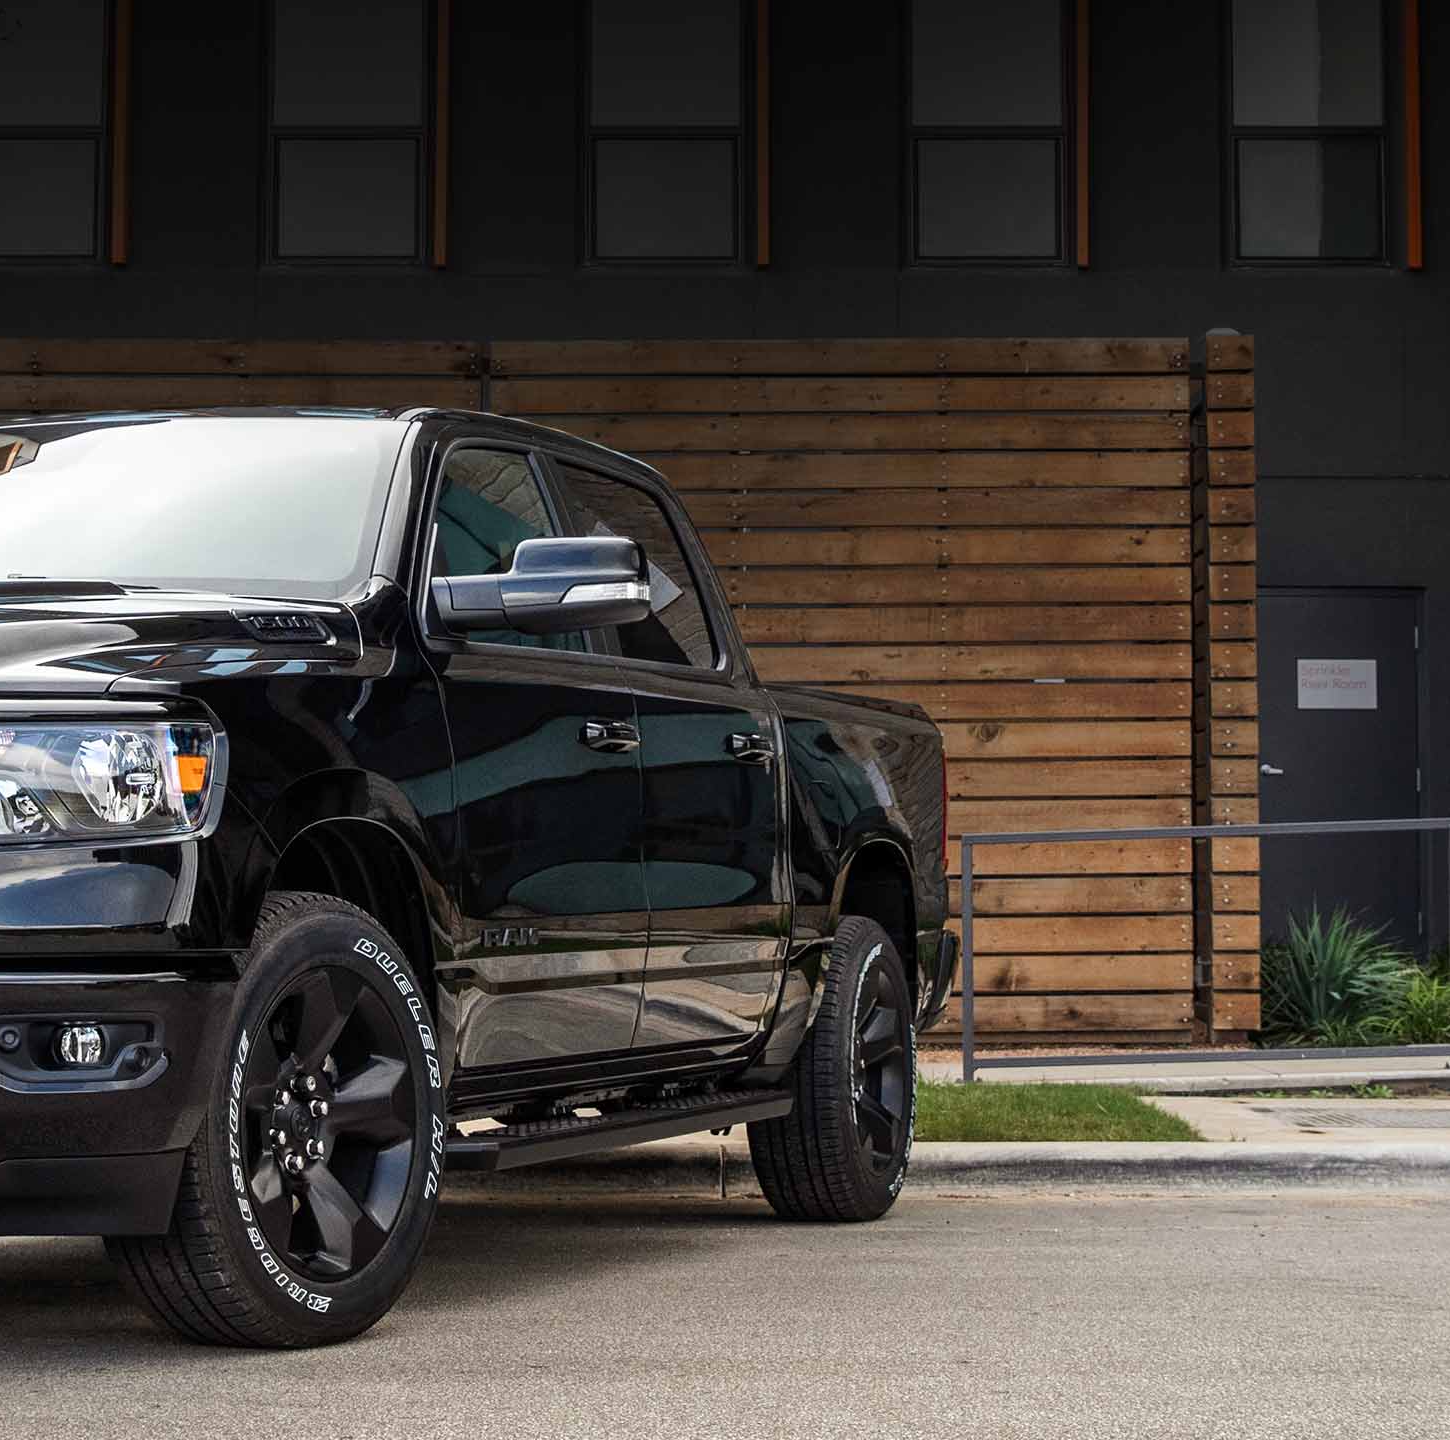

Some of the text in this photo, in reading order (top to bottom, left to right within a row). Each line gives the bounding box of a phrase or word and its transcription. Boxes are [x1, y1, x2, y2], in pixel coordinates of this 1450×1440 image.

[250, 615, 313, 629] 1500
[1332, 678, 1367, 689] Room
[483, 927, 538, 946] RAM
[353, 938, 441, 1089] DUELER
[229, 1029, 332, 1313] BRIDGESTONE
